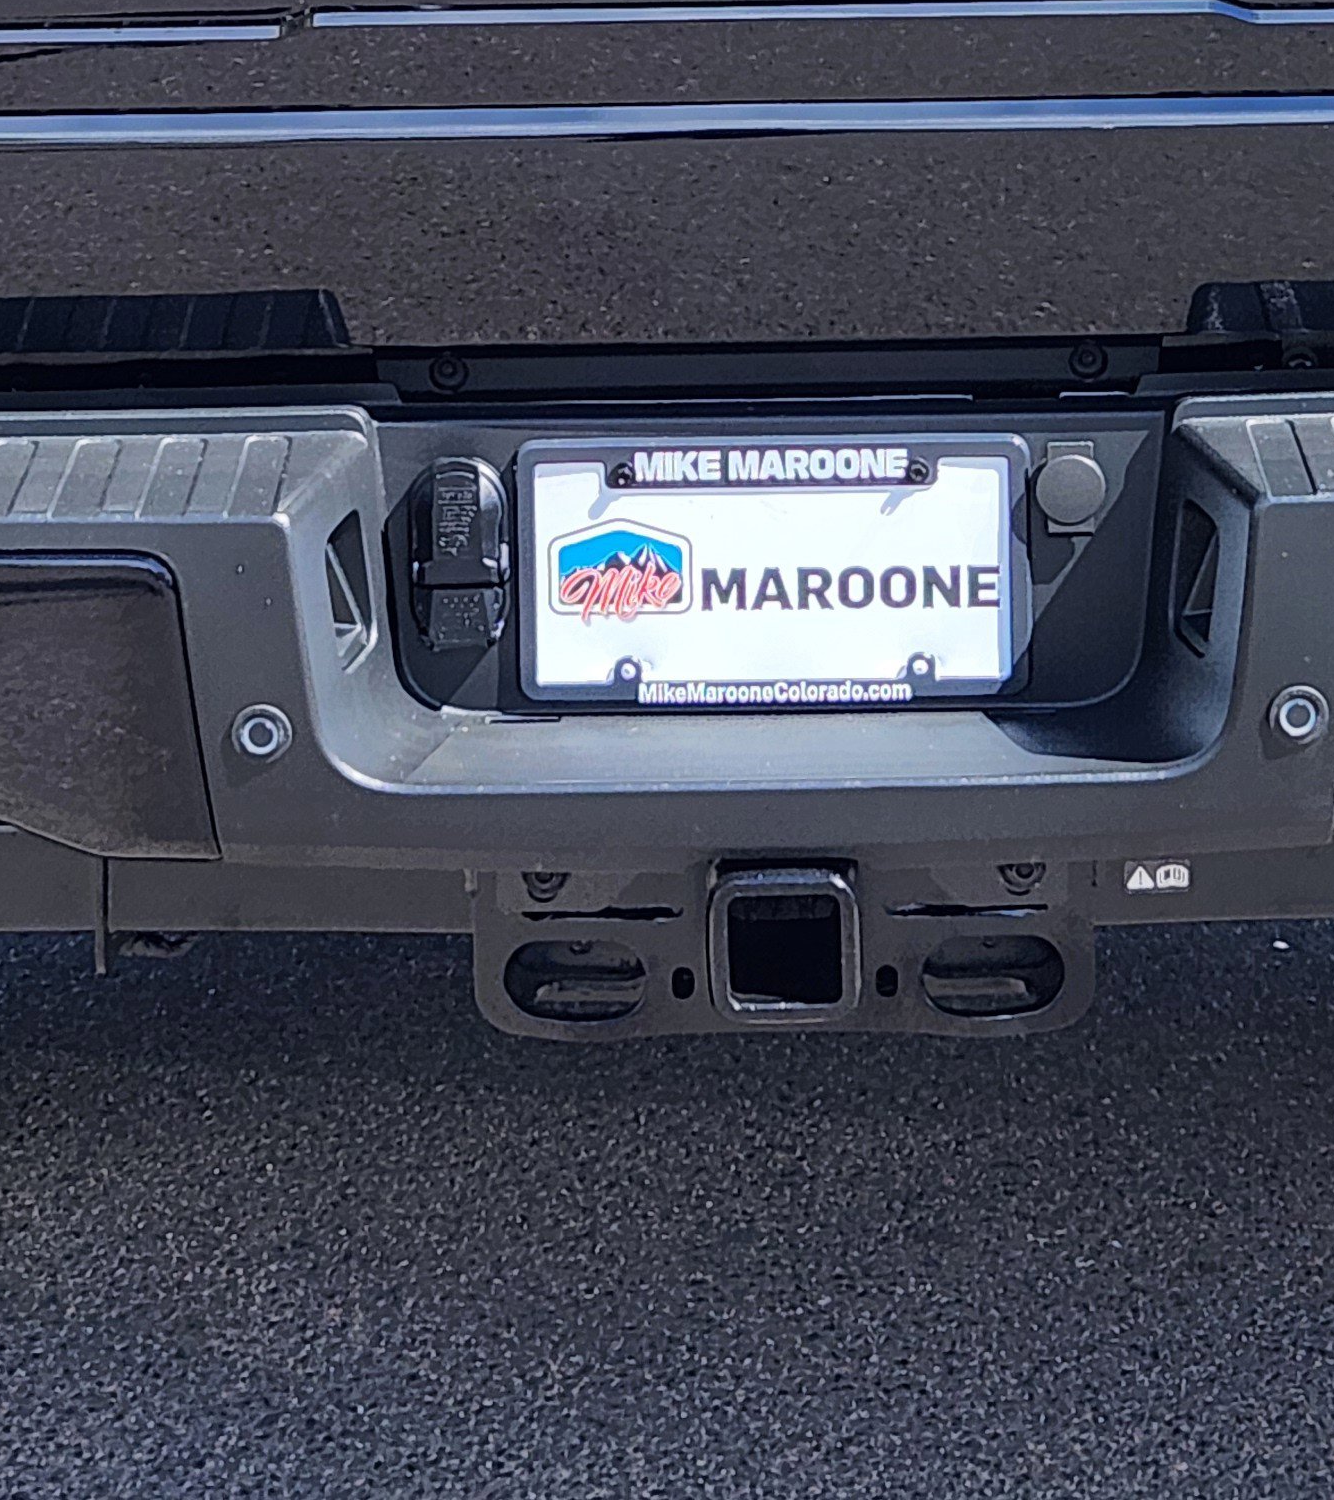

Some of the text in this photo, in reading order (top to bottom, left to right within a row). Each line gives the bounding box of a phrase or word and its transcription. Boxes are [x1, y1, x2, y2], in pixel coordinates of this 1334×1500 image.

[634, 448, 909, 483] MIKE MAROONE
[560, 560, 1001, 622] Mike MAROONE
[638, 680, 913, 704] MikeMarooneColorado.com
